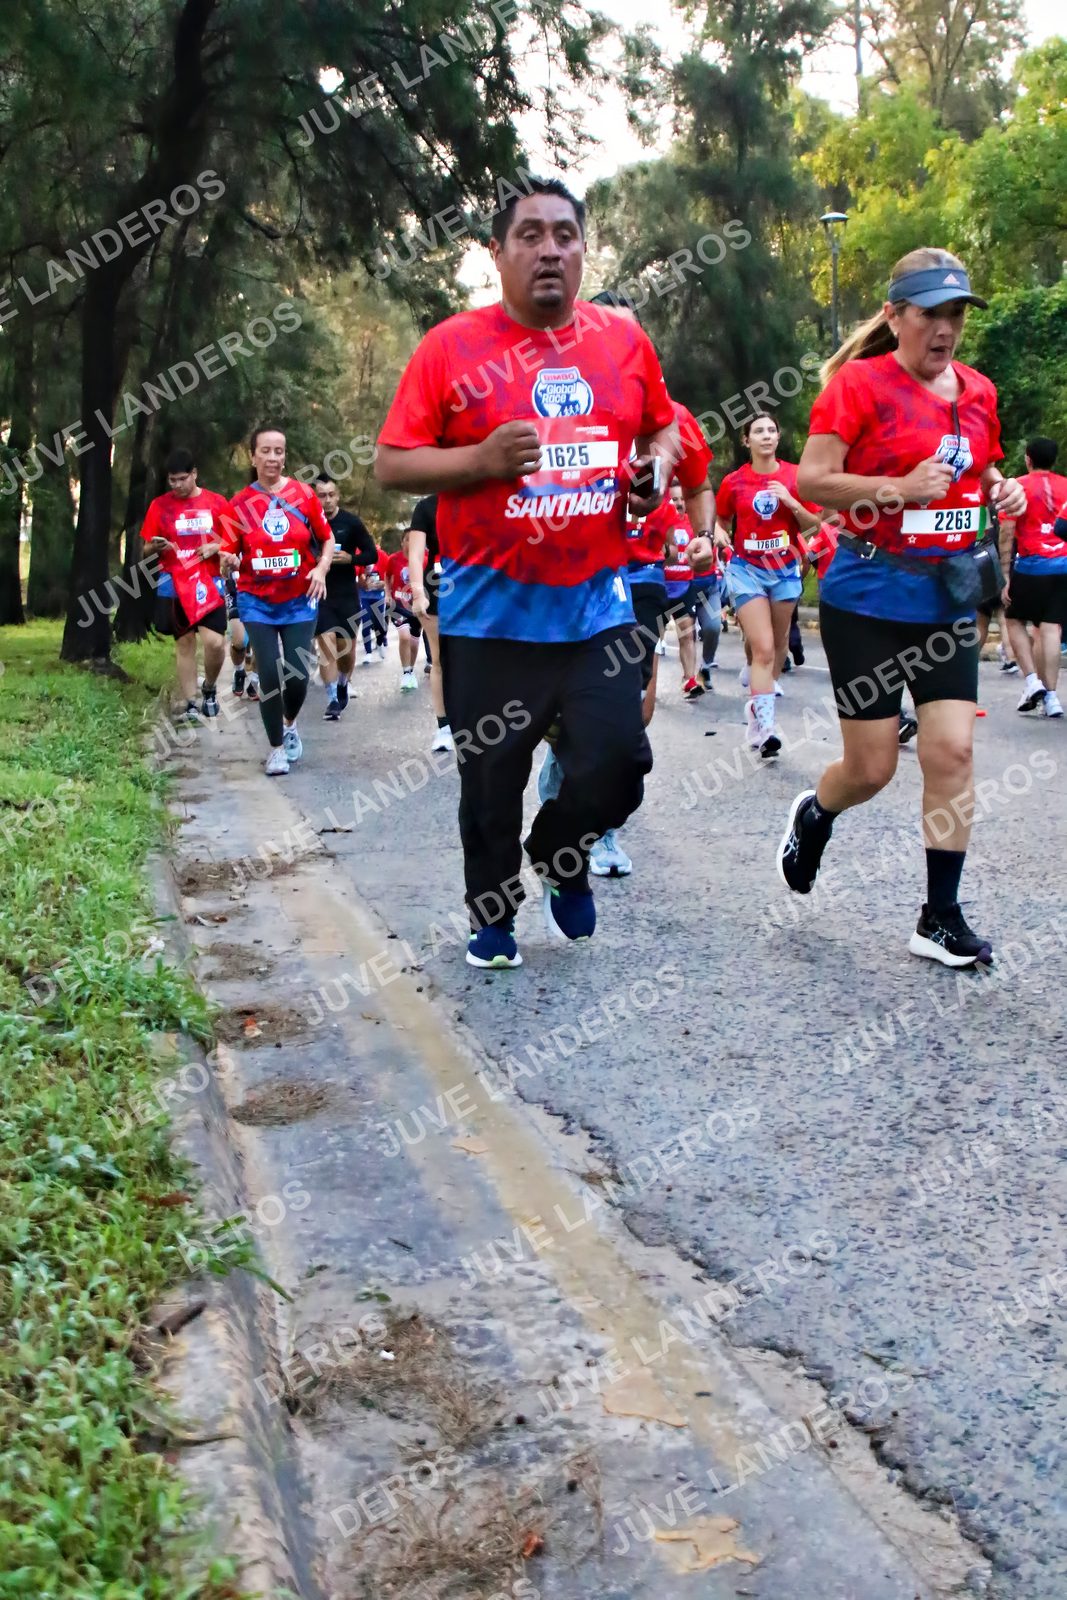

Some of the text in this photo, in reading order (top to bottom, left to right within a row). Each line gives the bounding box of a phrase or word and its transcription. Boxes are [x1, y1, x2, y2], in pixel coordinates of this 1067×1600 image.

[546, 383, 577, 395] Global
[542, 393, 567, 404] Race
[546, 445, 590, 468] 1625
[504, 491, 616, 519] SANTIAGO
[934, 509, 973, 532] 2263
[757, 538, 780, 550] 17680
[263, 557, 289, 568] 17682
